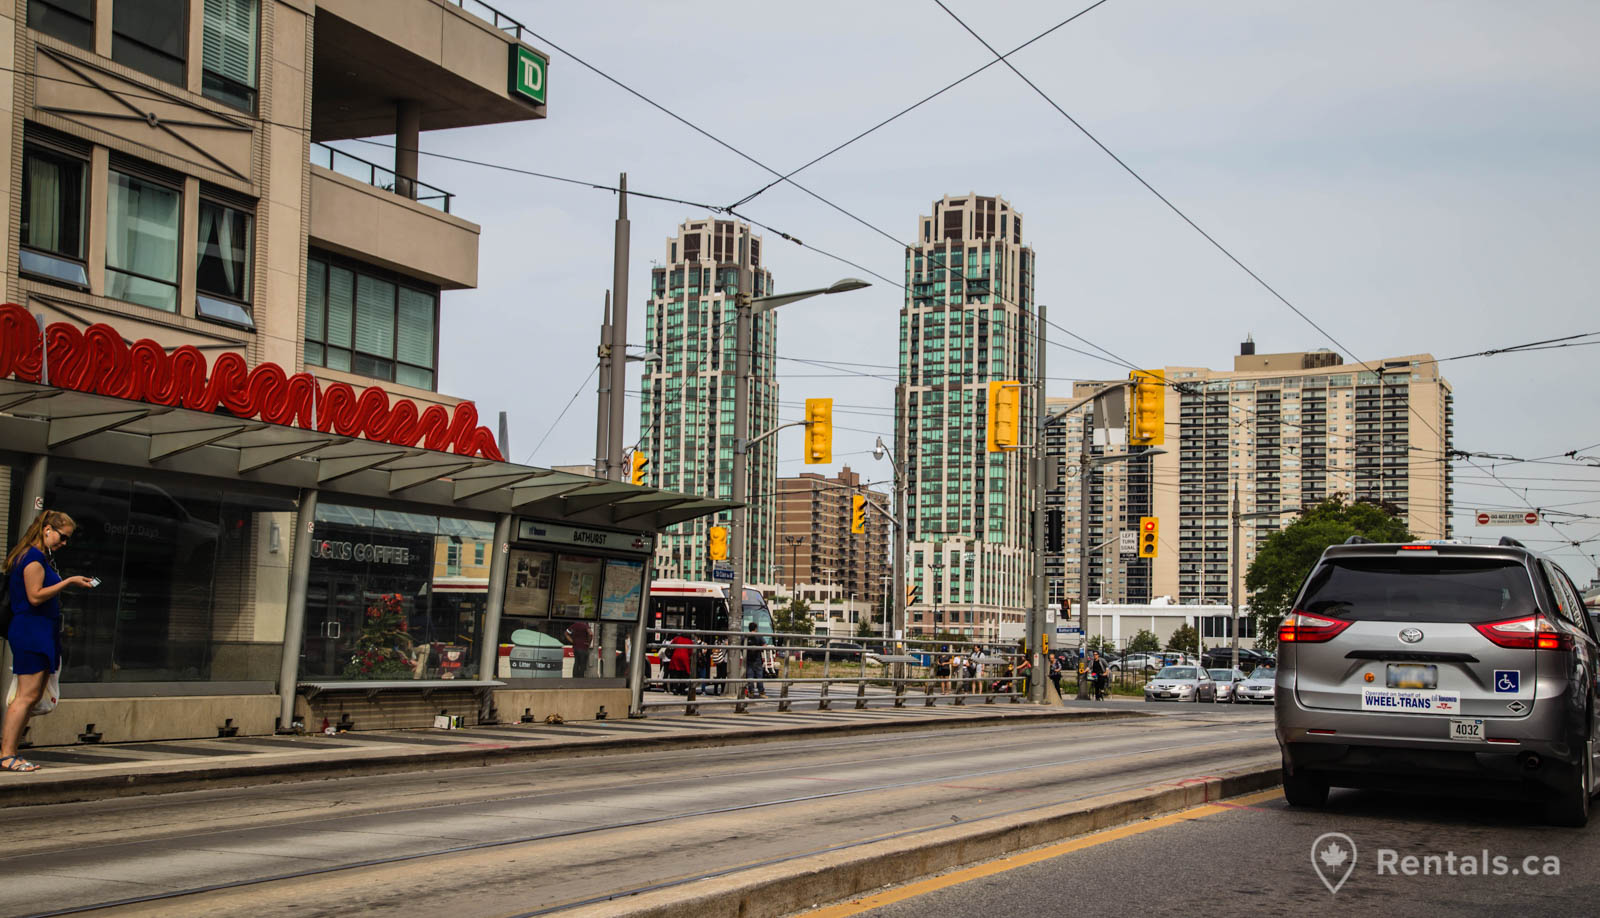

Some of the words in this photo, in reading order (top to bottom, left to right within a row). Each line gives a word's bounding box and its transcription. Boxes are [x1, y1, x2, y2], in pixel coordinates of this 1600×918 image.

[520, 55, 542, 91] TD
[573, 531, 607, 545] BATHURST
[354, 542, 409, 565] COFFEE
[1456, 724, 1479, 736] 4032
